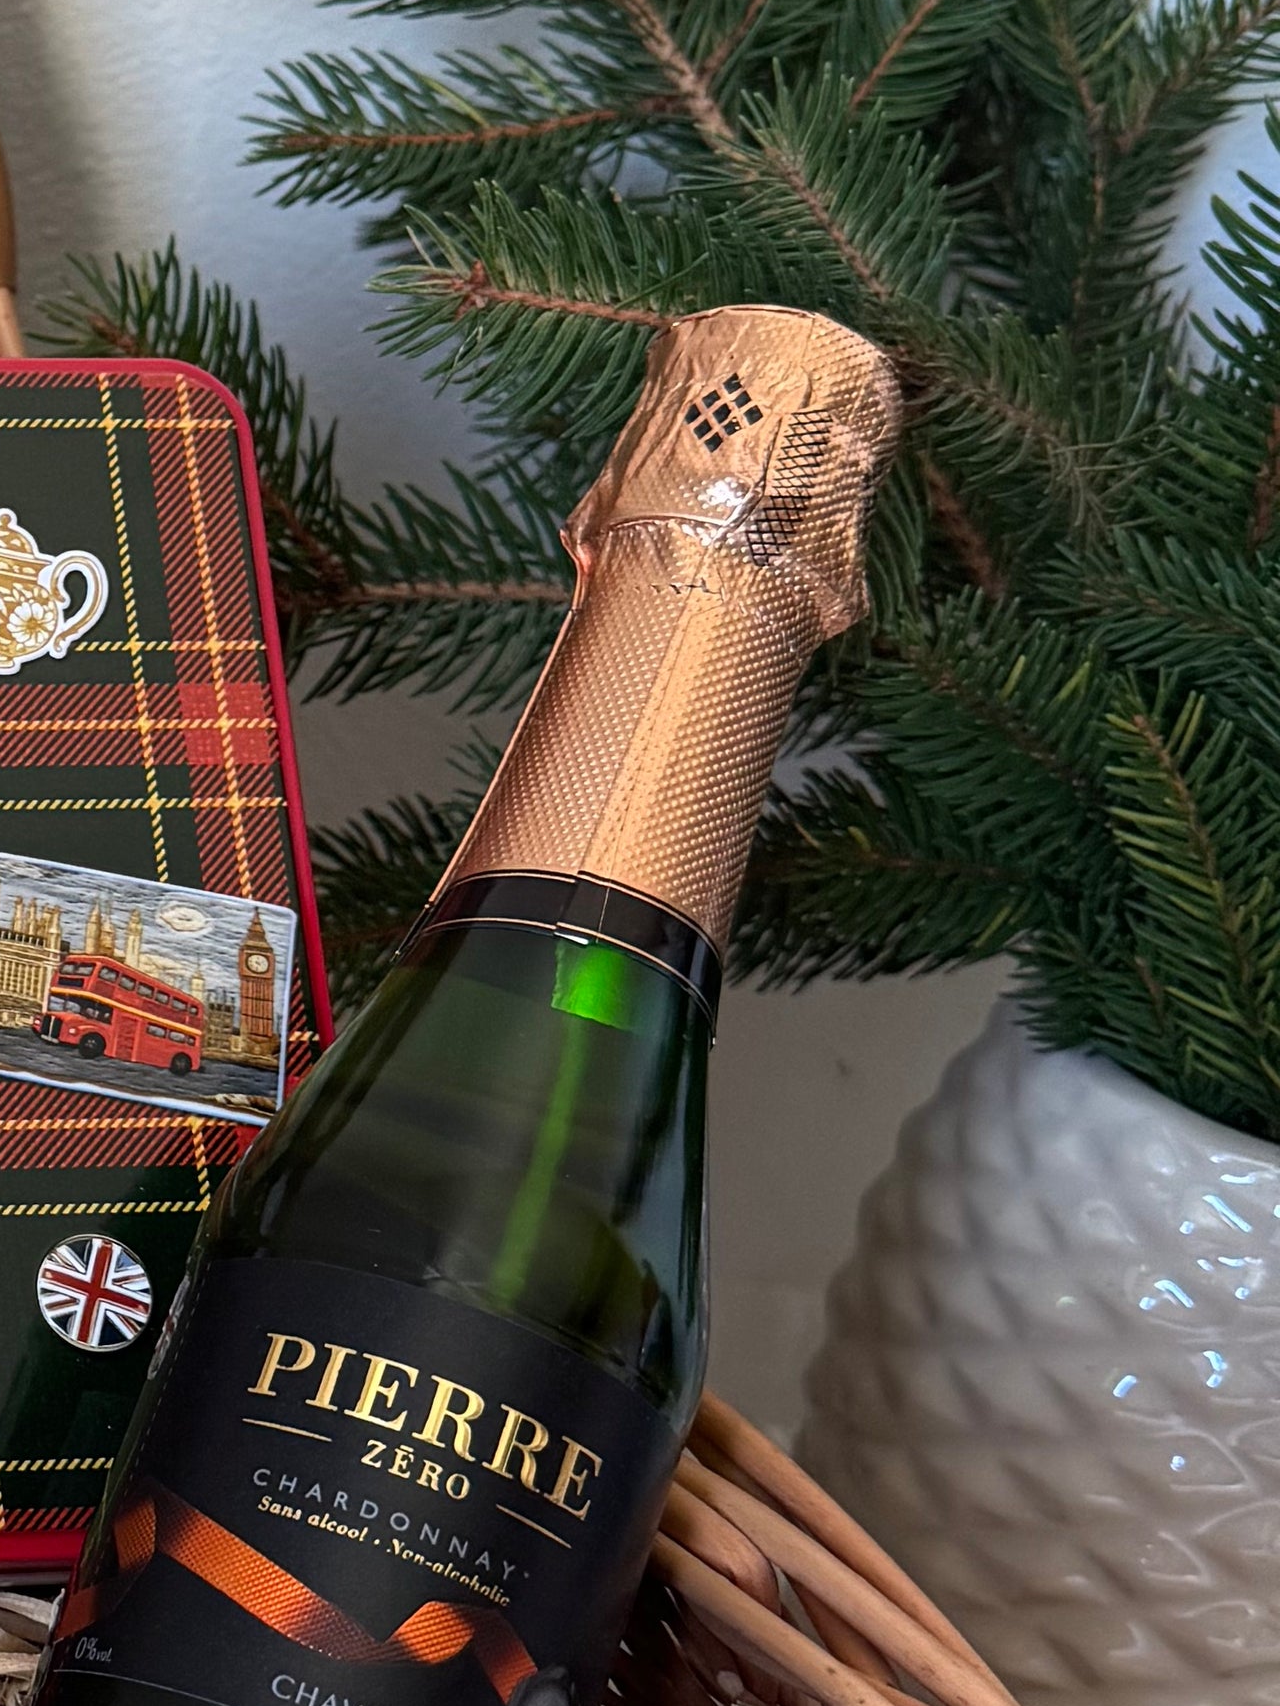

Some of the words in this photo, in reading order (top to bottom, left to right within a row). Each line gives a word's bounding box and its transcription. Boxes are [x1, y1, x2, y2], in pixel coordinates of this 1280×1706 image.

[246, 1331, 603, 1520] PIERRE
[257, 1495, 303, 1521] Sans
[307, 1513, 369, 1542] alcool
[386, 1537, 511, 1607] Non-alcoholic
